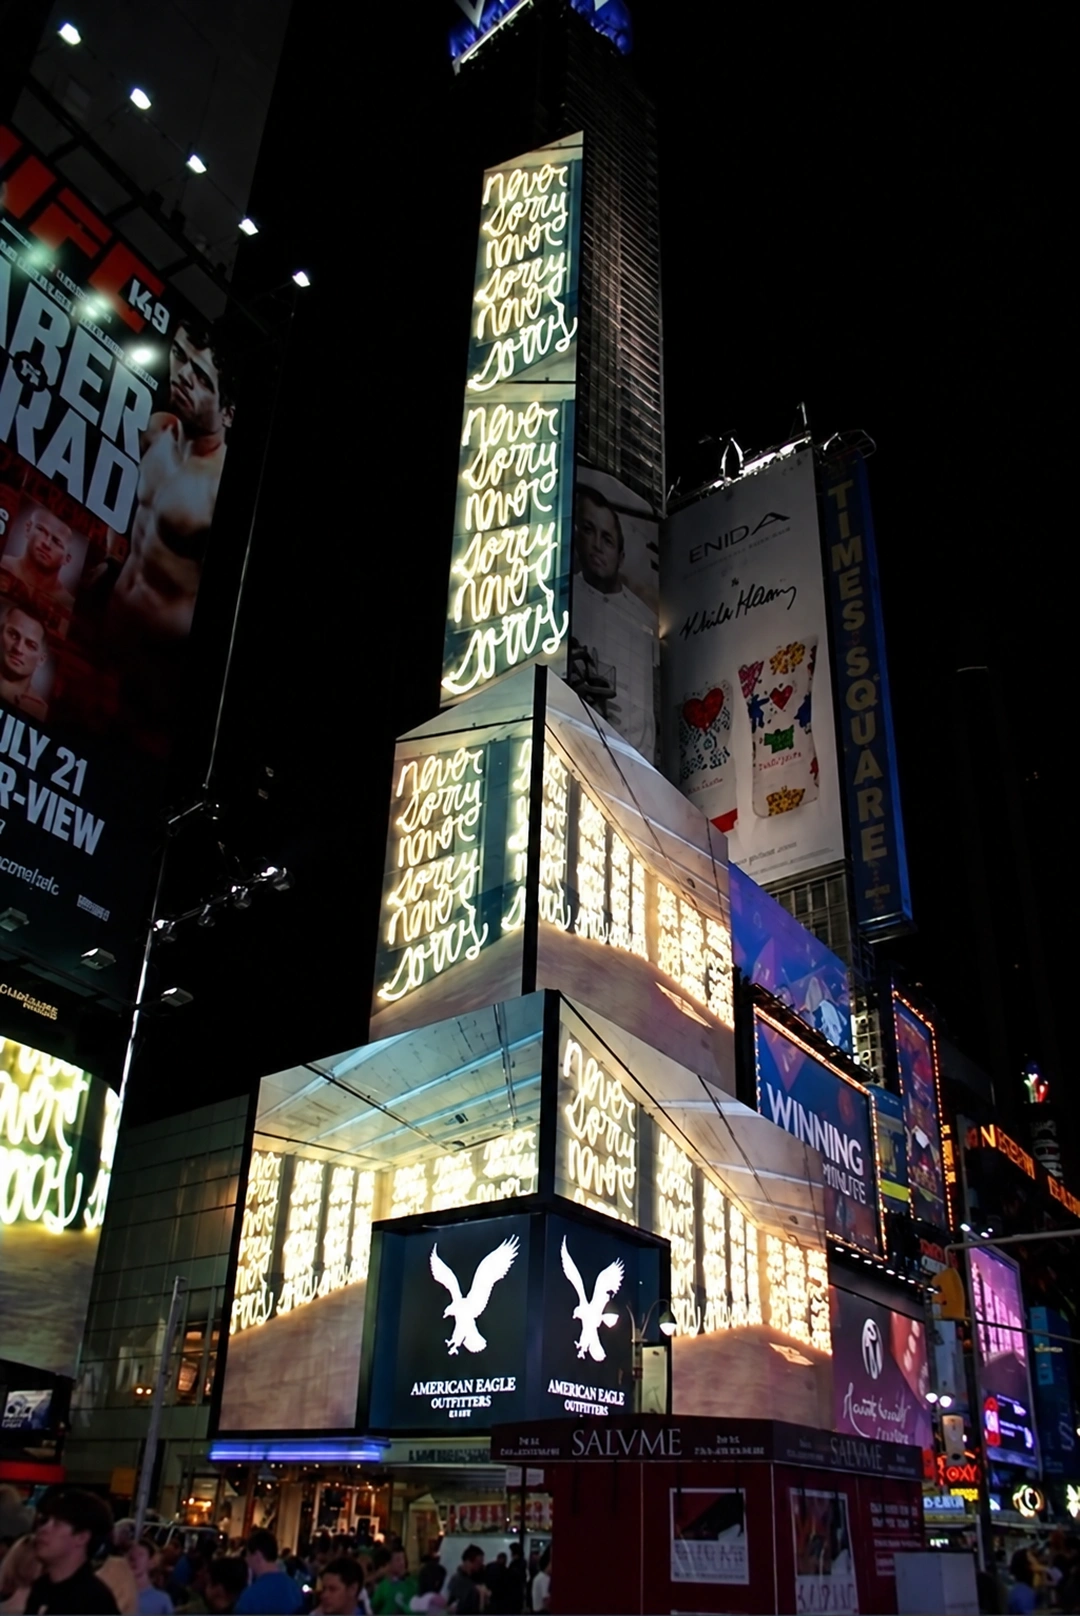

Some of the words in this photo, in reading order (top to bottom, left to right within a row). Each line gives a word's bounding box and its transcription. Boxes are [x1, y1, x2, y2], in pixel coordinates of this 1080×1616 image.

[828, 479, 866, 632] TIMES
[845, 645, 889, 862] SQUARE
[50, 746, 88, 797] 21
[766, 1082, 864, 1177] WINNING
[411, 1379, 474, 1396] AMERICAN
[475, 1377, 517, 1393] EAGLE
[548, 1379, 597, 1401] AMERICAN
[598, 1387, 625, 1407] EAGLE
[431, 1396, 492, 1409] OUTFITTERS
[564, 1399, 609, 1416] OUTFITTERS
[571, 1428, 682, 1457] SALVME
